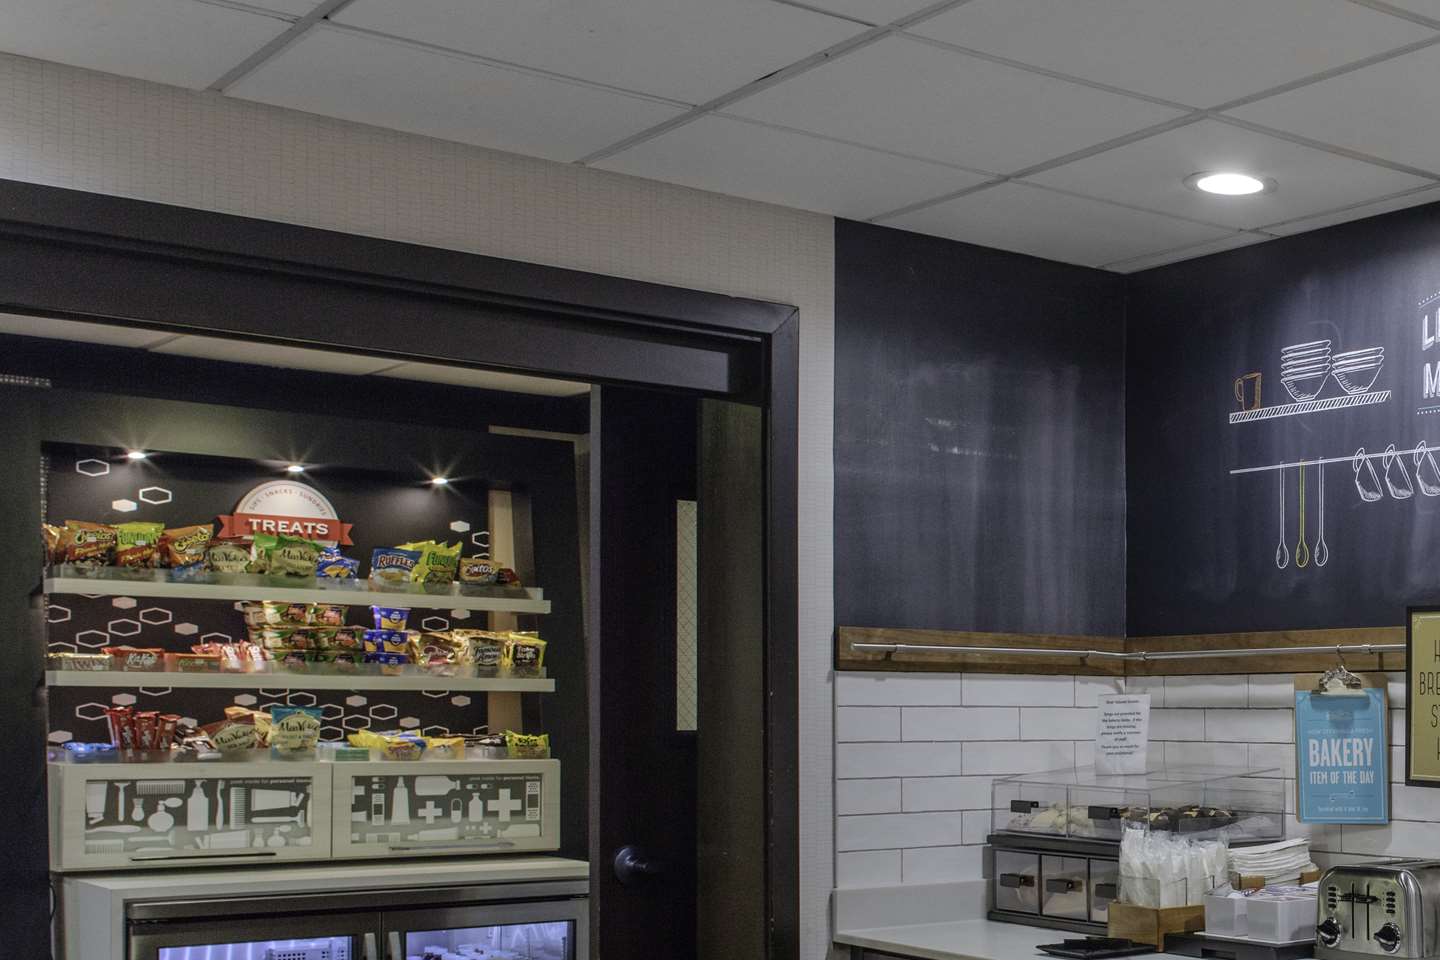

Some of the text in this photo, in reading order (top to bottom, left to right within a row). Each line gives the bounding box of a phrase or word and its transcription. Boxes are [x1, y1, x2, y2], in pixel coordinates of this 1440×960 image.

[248, 518, 329, 535] TREATS
[1309, 737, 1374, 767] BAKERY
[1310, 771, 1374, 785] ITEM OF THE DAY
